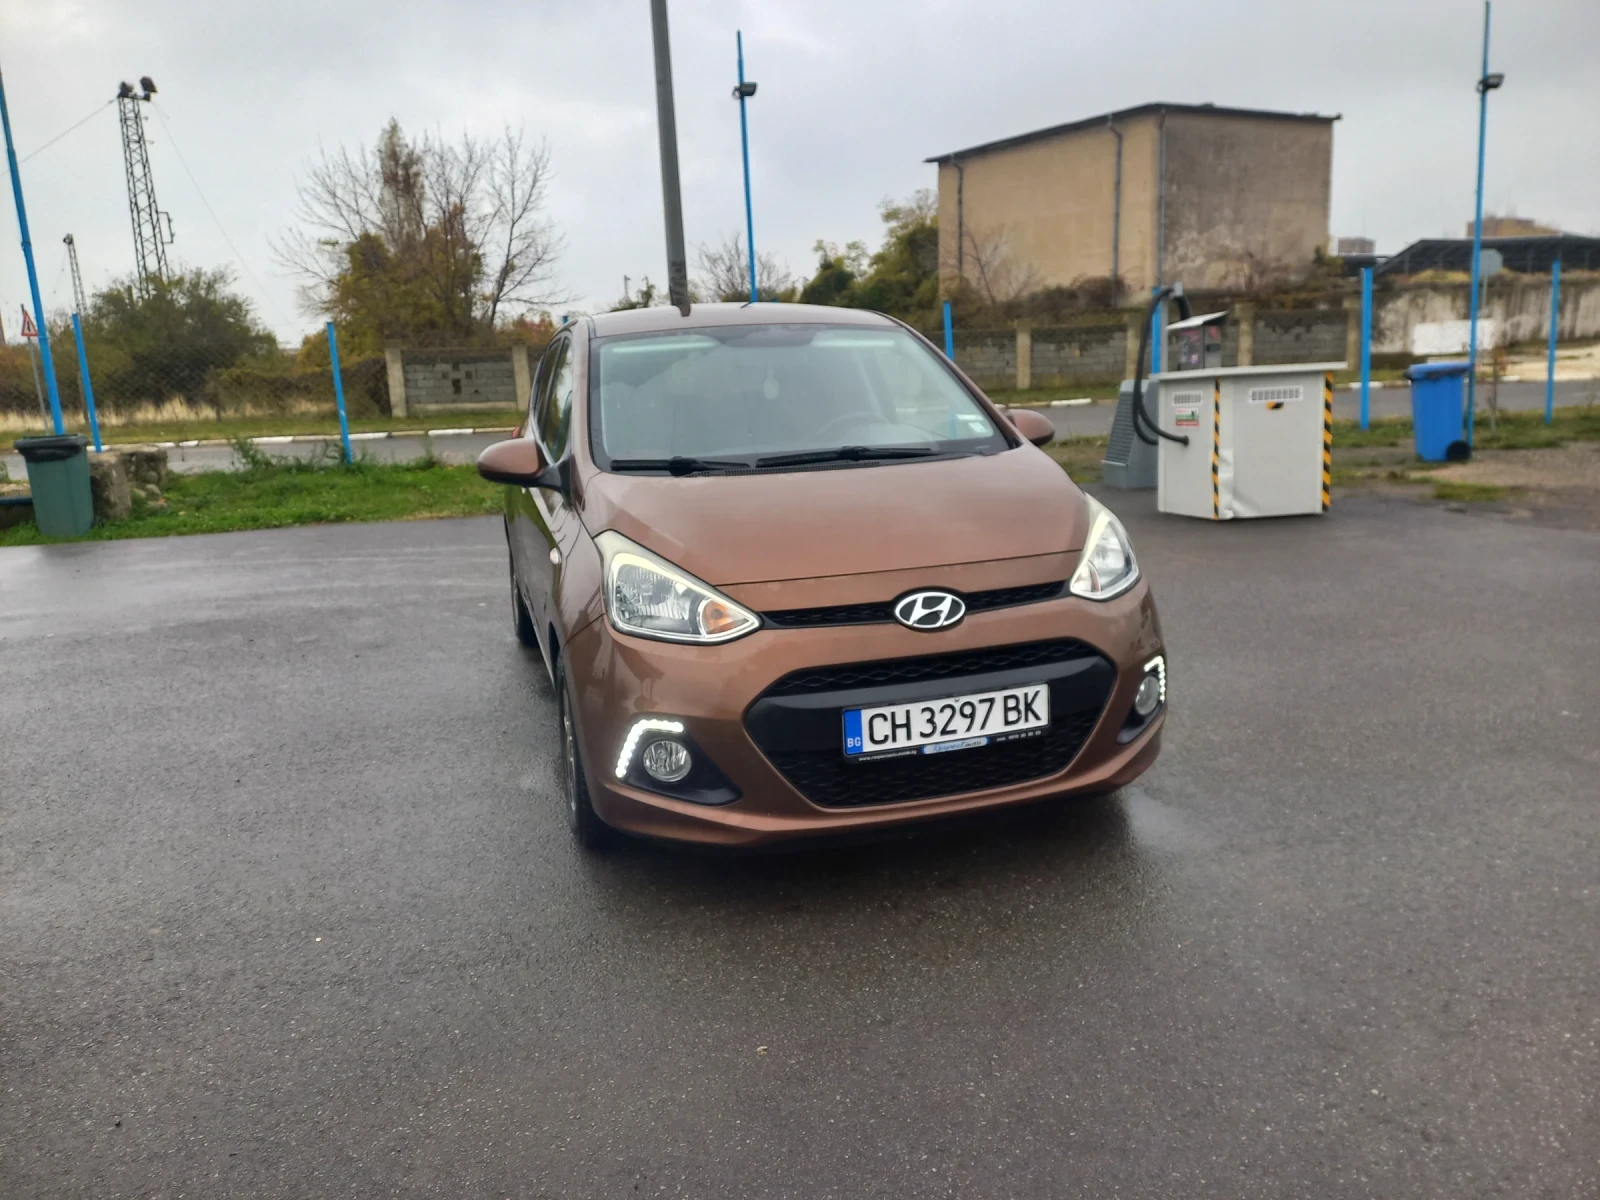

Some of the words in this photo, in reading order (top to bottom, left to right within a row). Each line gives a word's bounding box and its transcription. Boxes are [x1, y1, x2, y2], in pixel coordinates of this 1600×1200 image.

[868, 709, 912, 745] CH
[919, 697, 996, 738] 3297
[1003, 690, 1042, 727] BK
[847, 737, 861, 748] BG
